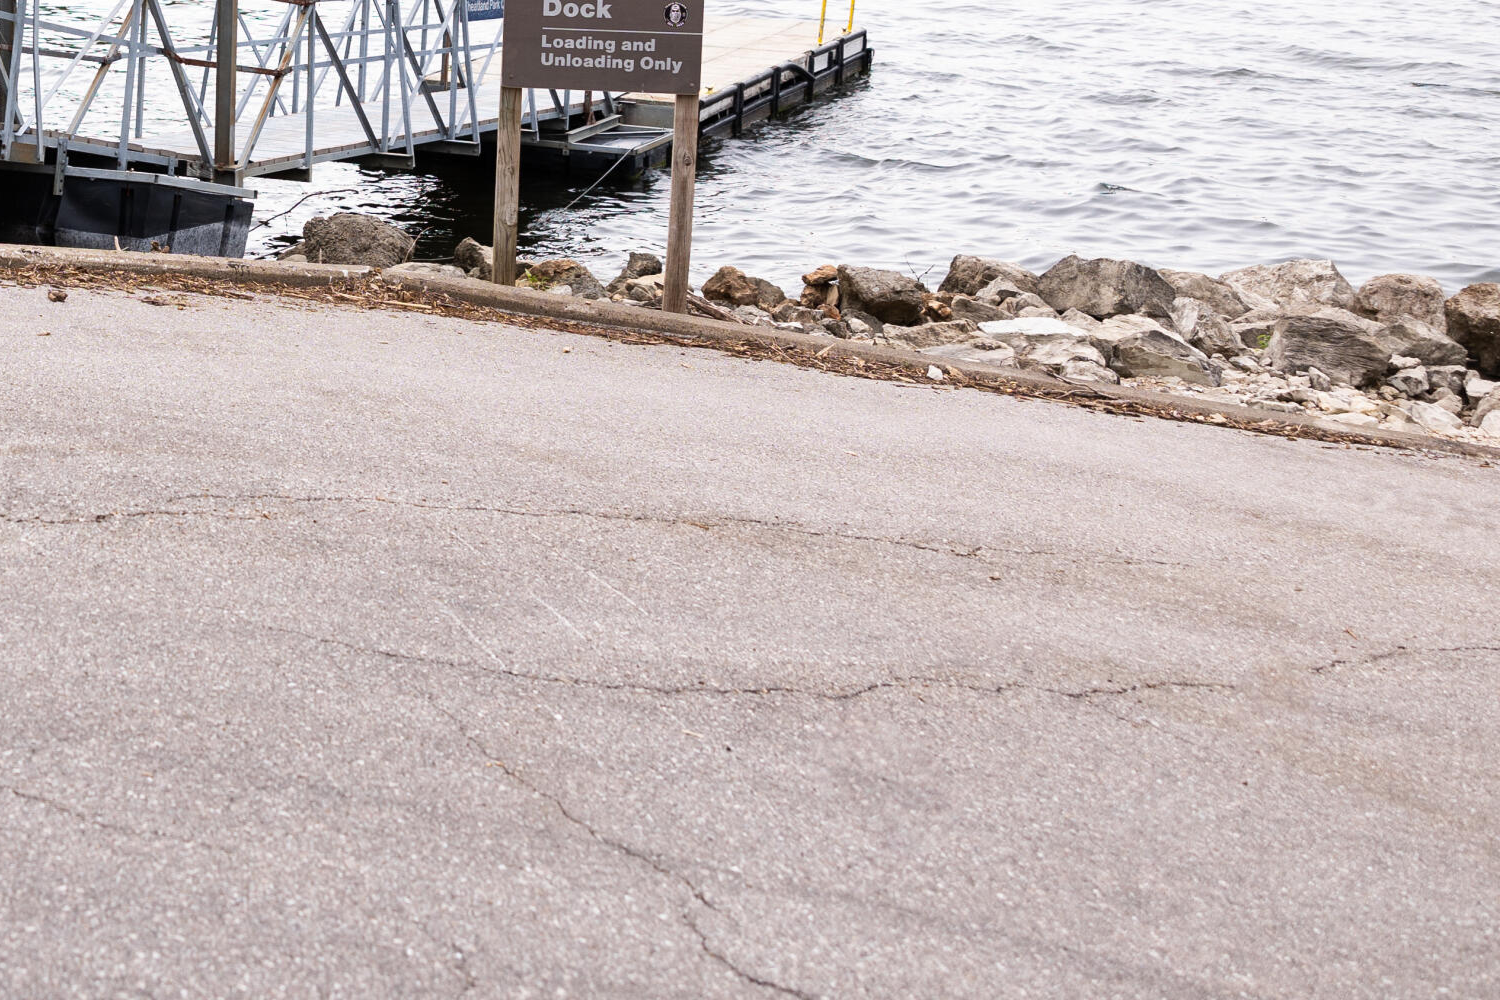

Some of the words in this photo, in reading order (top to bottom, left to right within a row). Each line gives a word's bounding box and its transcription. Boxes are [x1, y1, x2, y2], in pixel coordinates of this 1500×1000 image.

[541, 34, 616, 53] Loading
[621, 38, 656, 52] and
[540, 52, 635, 72] Unloading
[639, 56, 683, 74] Only
